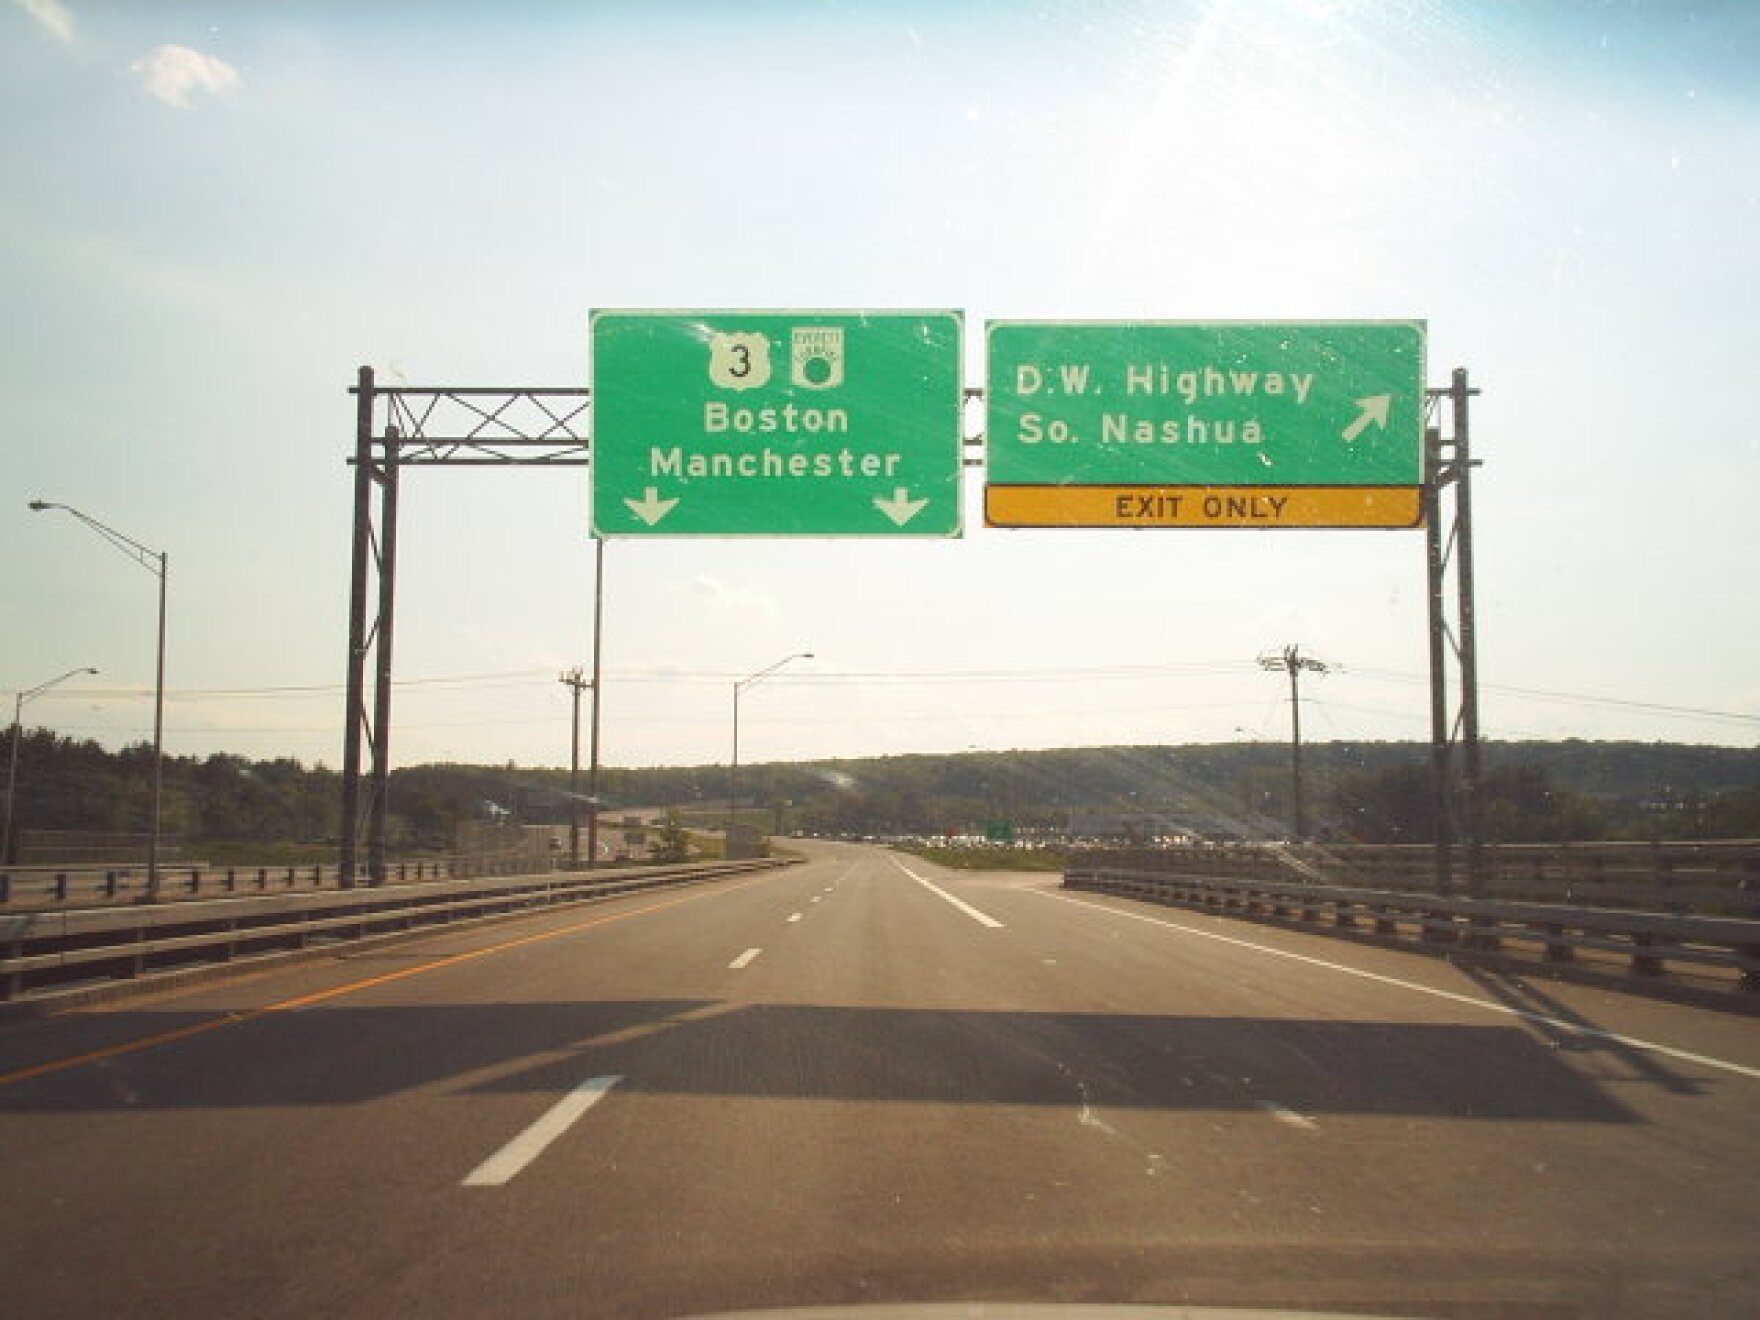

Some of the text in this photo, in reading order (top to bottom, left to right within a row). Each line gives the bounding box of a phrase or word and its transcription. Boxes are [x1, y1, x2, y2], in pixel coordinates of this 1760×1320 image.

[728, 344, 751, 377] 3
[1016, 365, 1314, 403] D.W. Highway
[704, 403, 848, 432] Boston
[1018, 414, 1264, 444] So. Nashua
[651, 448, 901, 477] Manchester
[1115, 496, 1287, 518] EXIT ONLY
